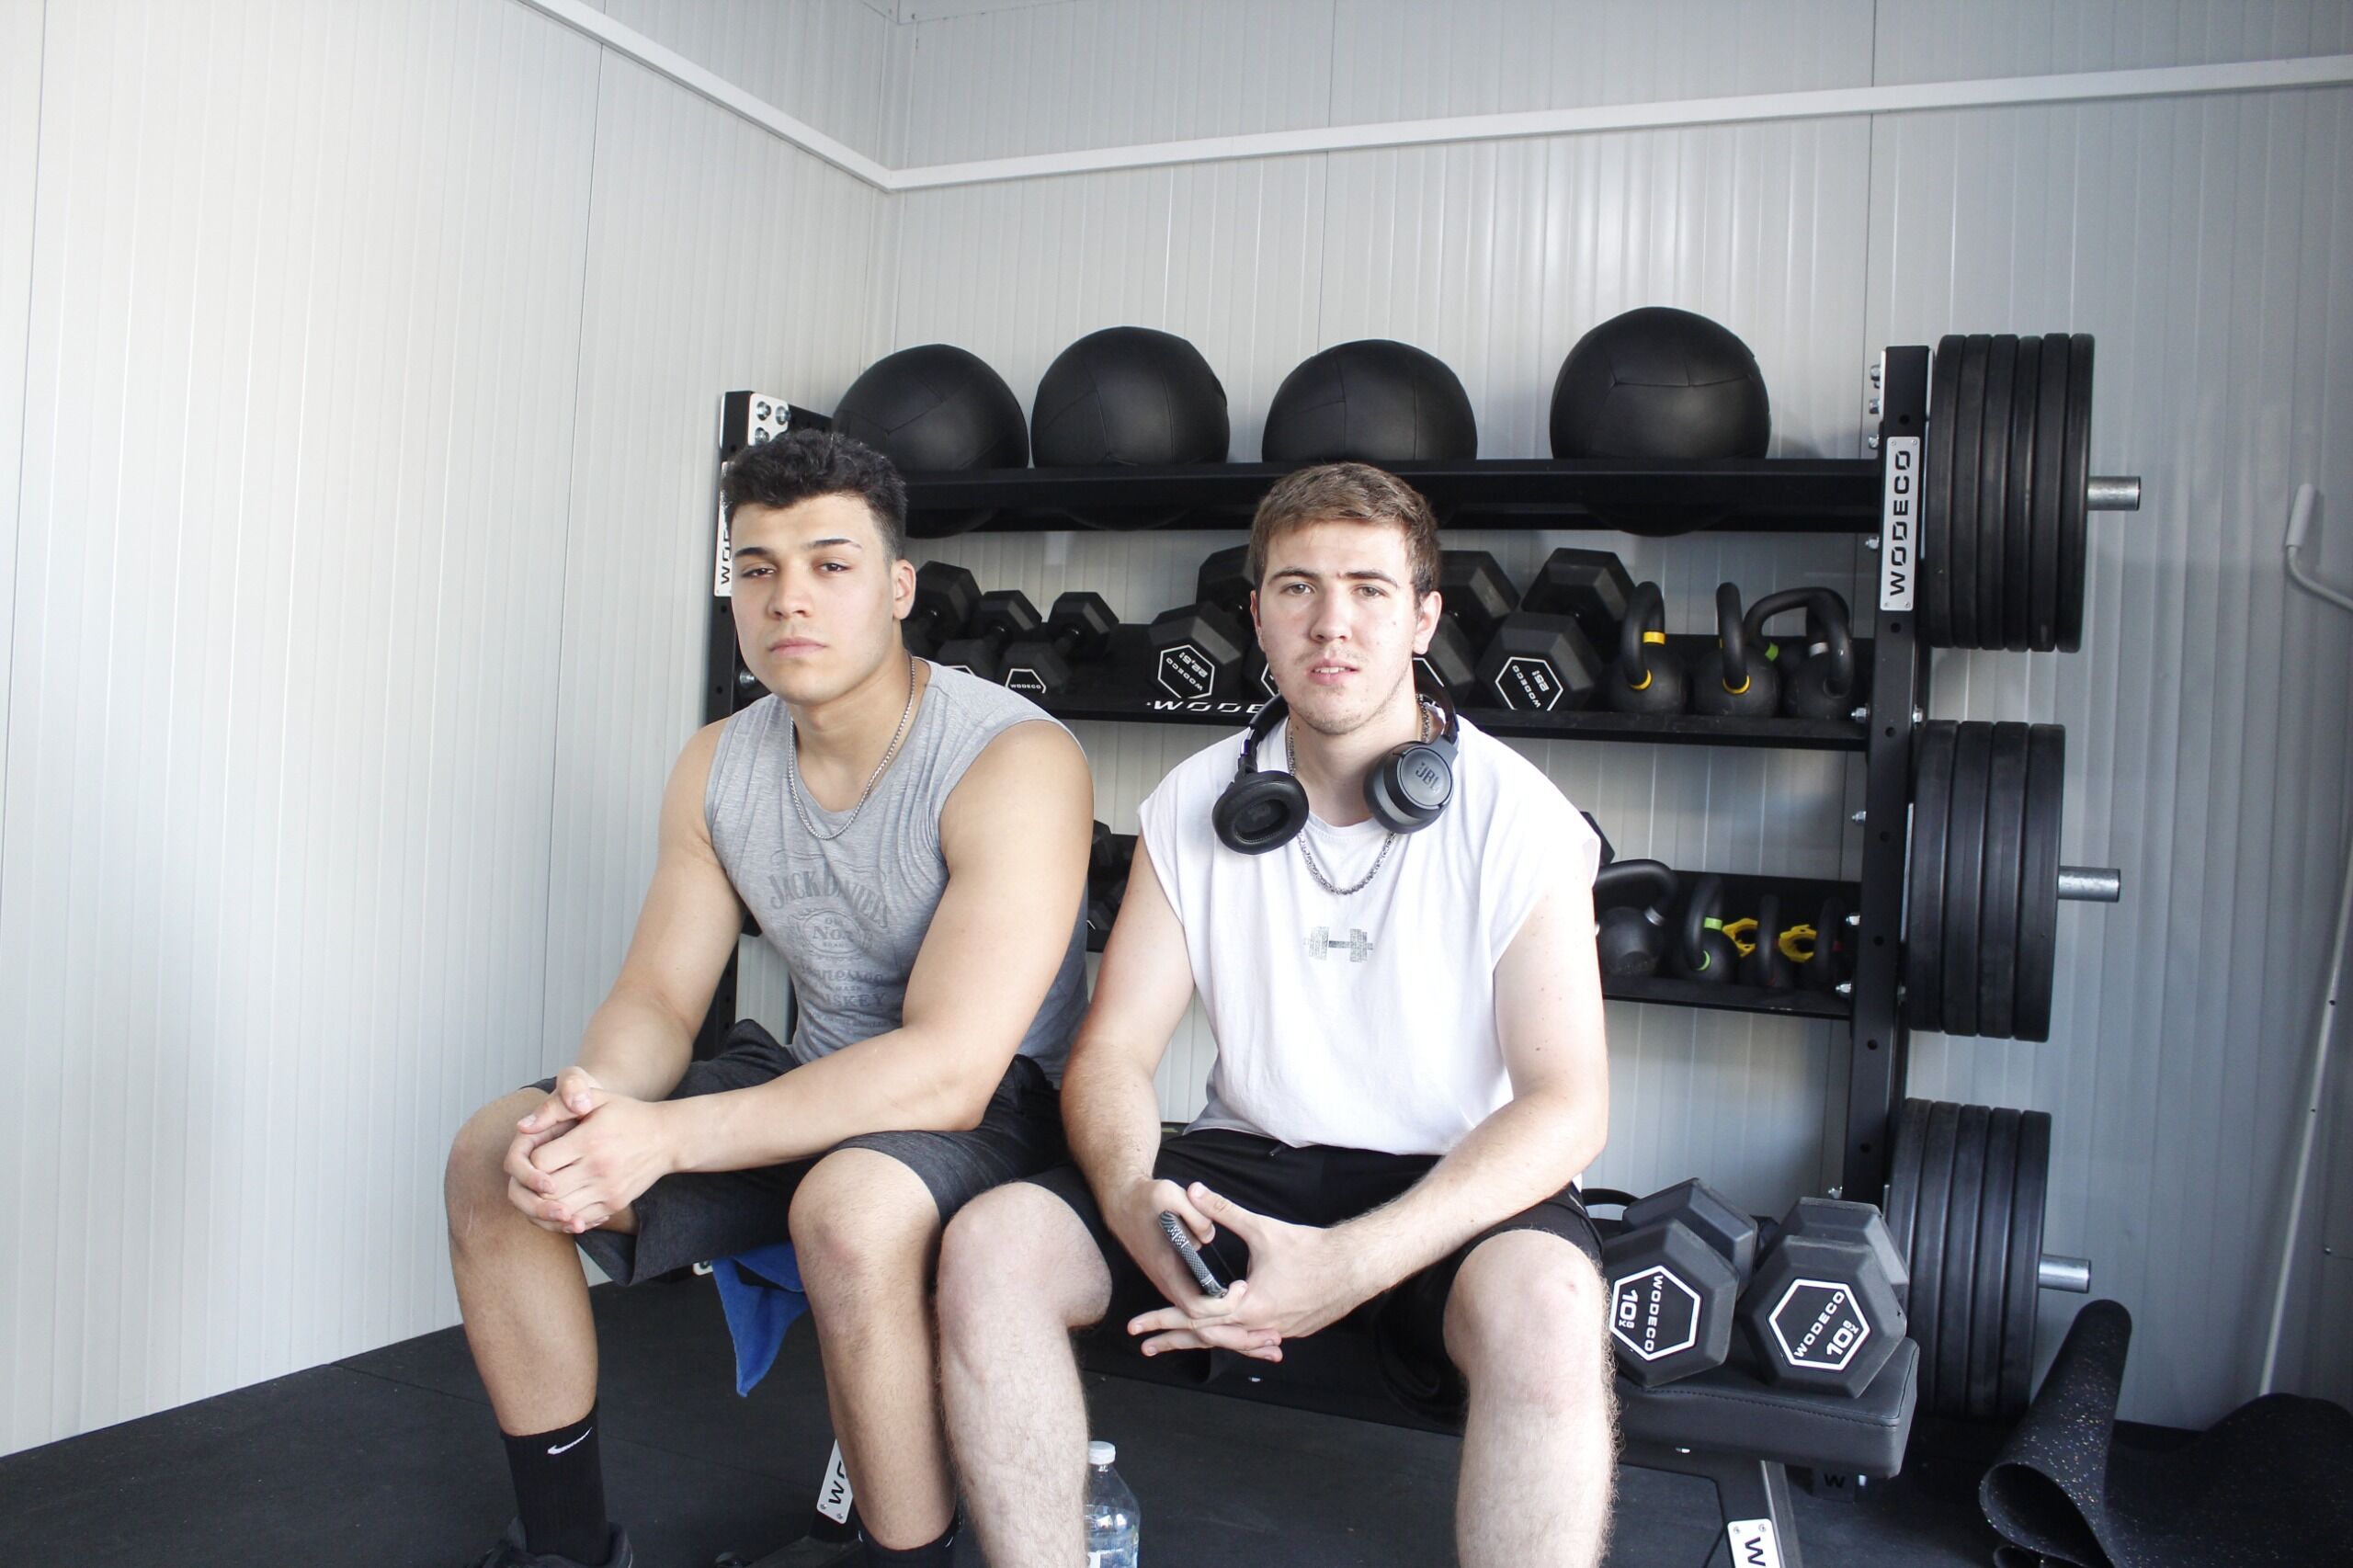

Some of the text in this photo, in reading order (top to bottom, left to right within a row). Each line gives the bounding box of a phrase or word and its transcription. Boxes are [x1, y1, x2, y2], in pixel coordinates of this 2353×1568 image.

[1890, 450, 1911, 597] WODECO
[1165, 656, 1203, 691] WODECO
[1511, 665, 1541, 709] WODECO
[1415, 761, 1441, 791] JBL
[1620, 1289, 1639, 1321] 10
[1644, 1275, 1664, 1352] WODECO
[1793, 1290, 1846, 1358] WODECO
[1826, 1327, 1854, 1356] 10
